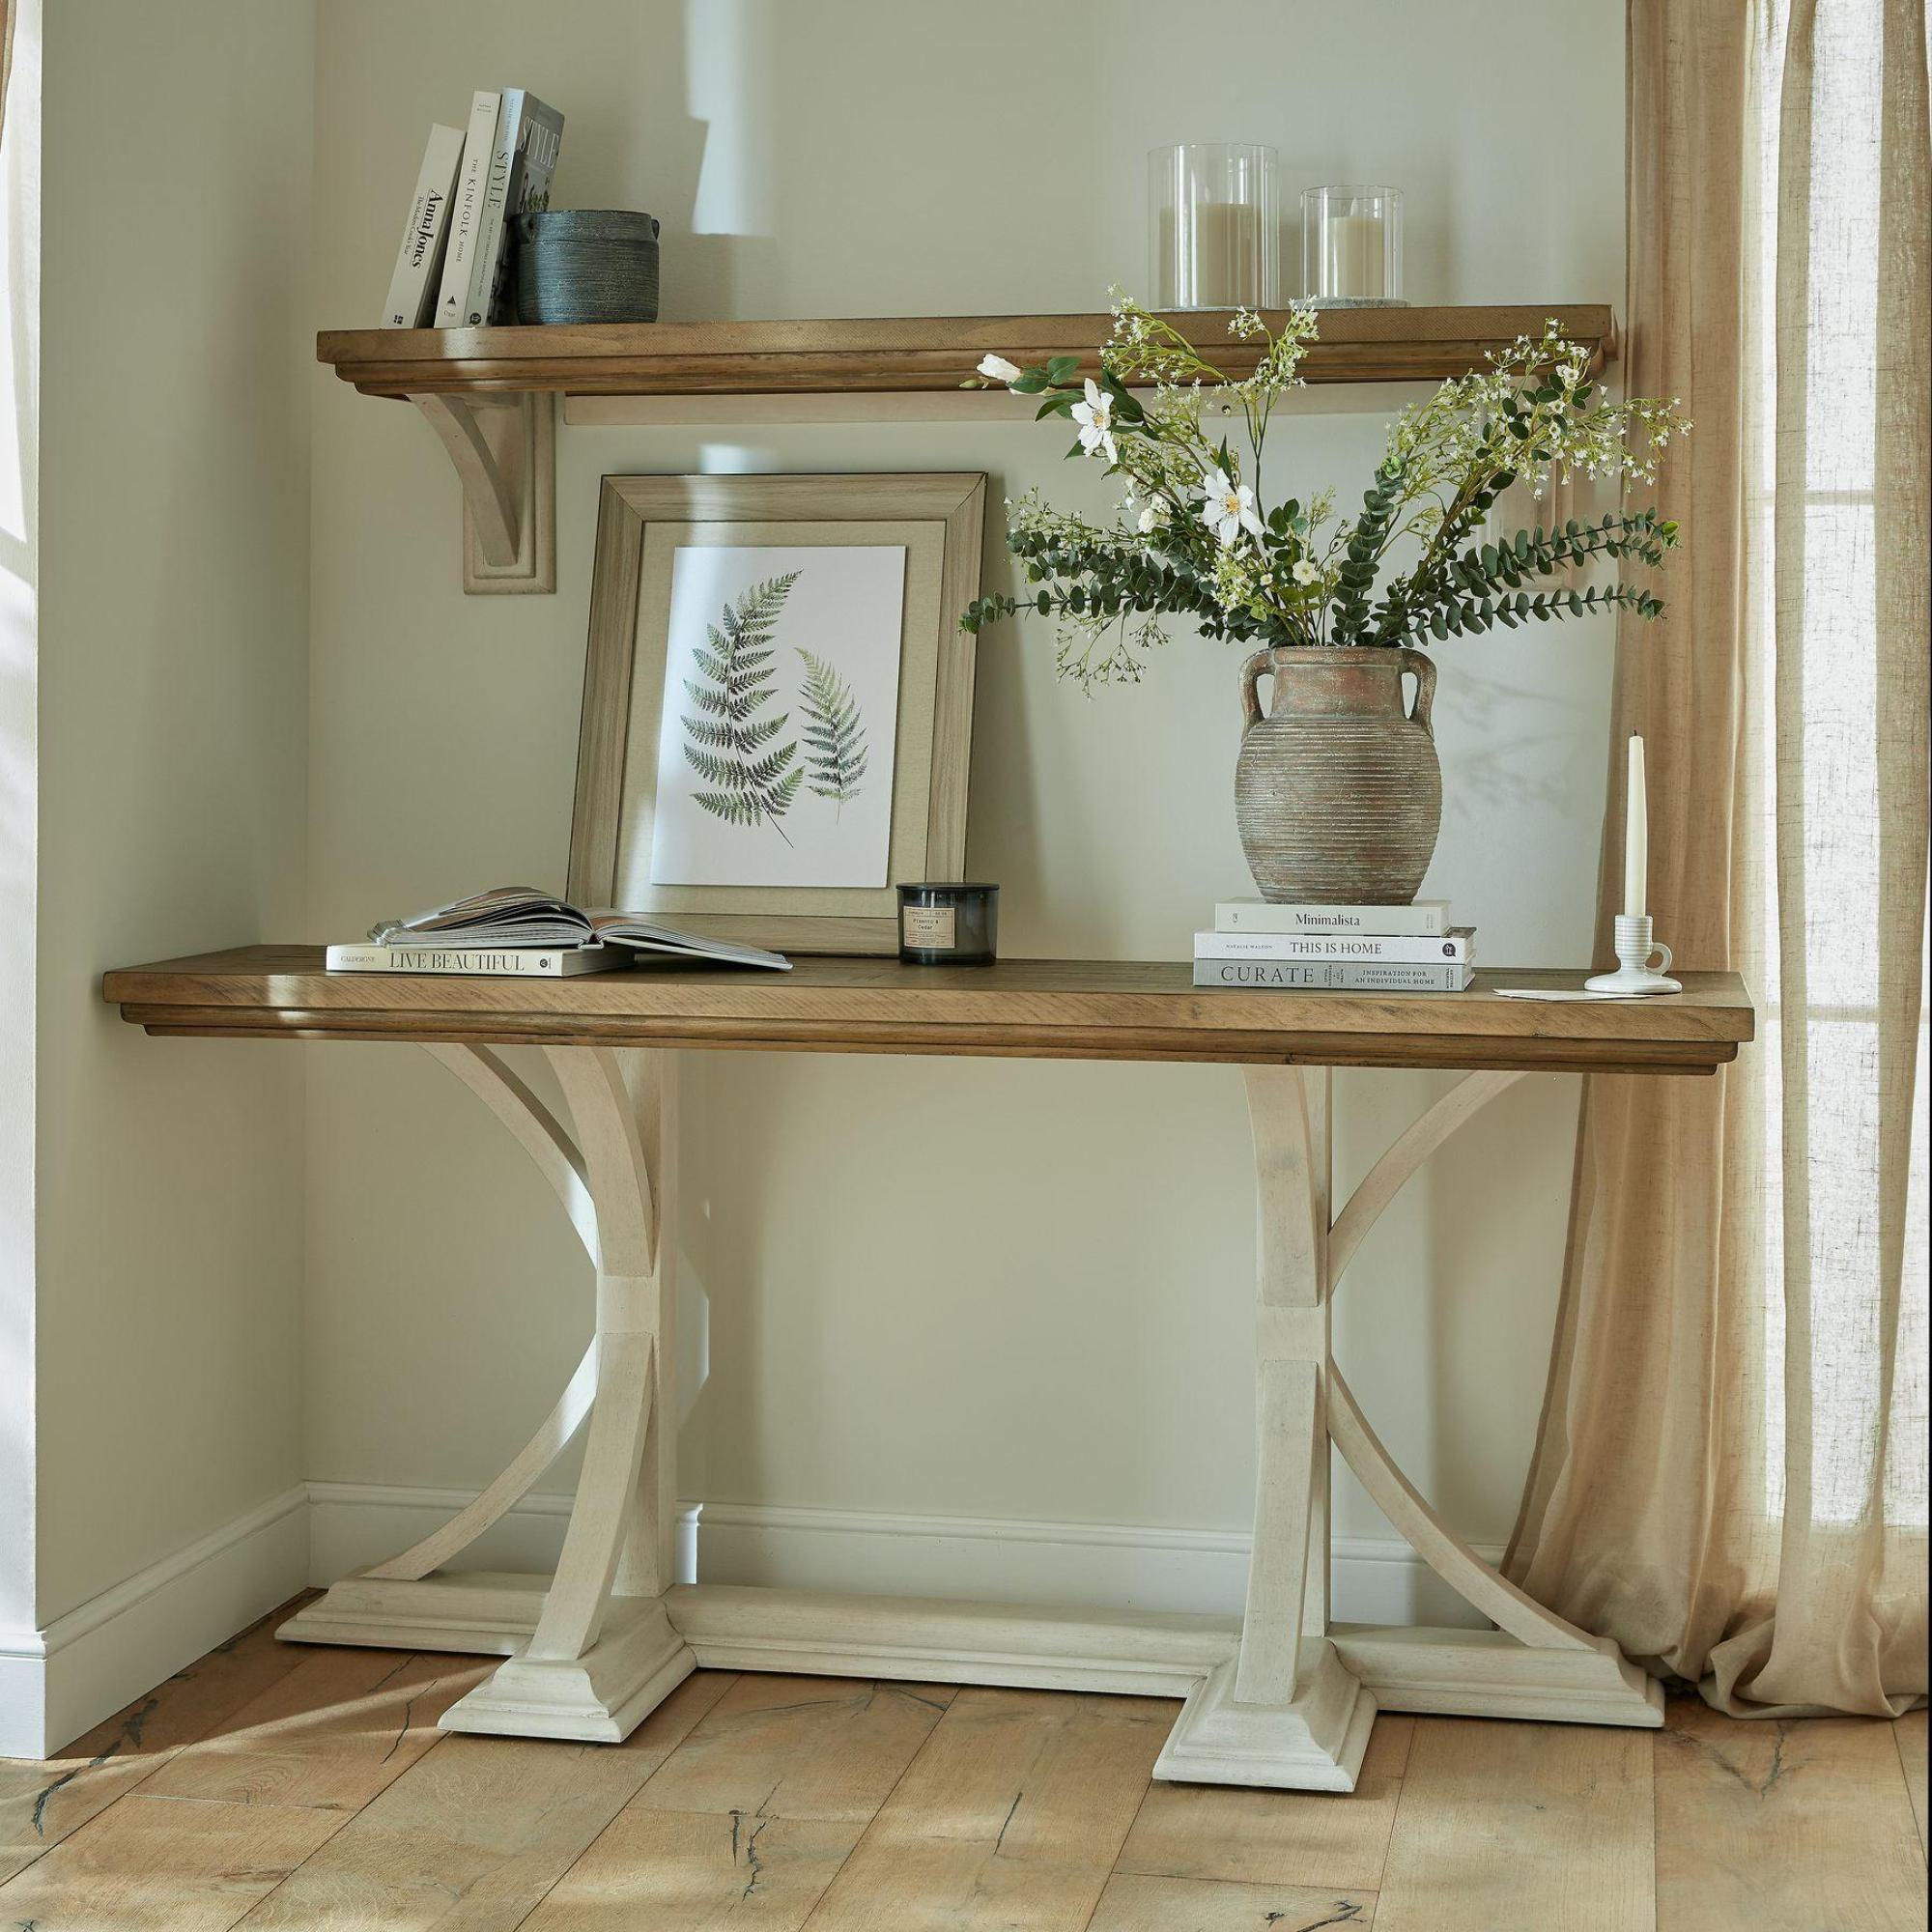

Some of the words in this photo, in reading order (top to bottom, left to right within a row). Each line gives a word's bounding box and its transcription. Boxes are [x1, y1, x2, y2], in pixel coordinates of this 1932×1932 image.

[520, 116, 559, 169] STYLE
[487, 150, 509, 209] STYLE
[422, 189, 443, 229] Anna
[458, 178, 476, 237] KINFOLK
[412, 227, 435, 269] Jones
[455, 241, 464, 263] HOME
[1295, 913, 1360, 927] Minimalista
[389, 952, 426, 969] LIVE
[432, 952, 526, 972] BEAUTIFUL
[1290, 942, 1321, 953] THIS
[1325, 942, 1337, 954] IS
[1341, 943, 1382, 955] HOME
[1220, 965, 1315, 983] CURATE
